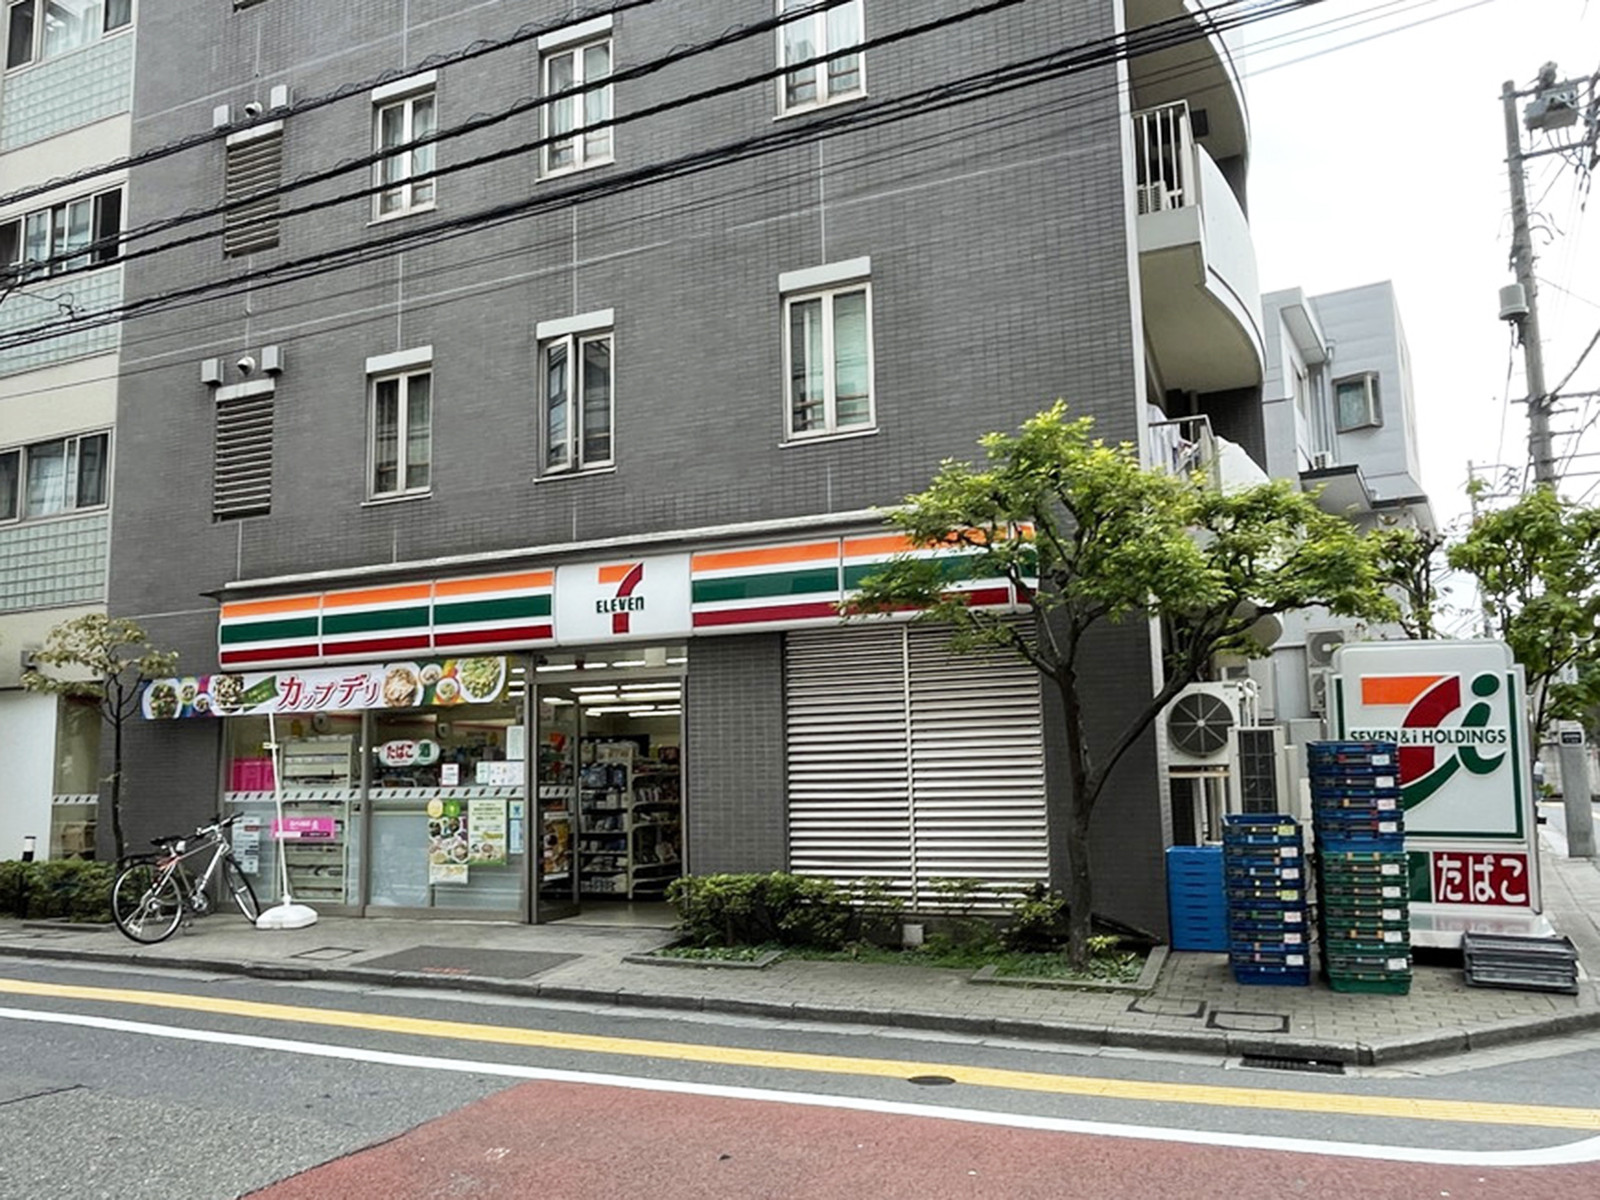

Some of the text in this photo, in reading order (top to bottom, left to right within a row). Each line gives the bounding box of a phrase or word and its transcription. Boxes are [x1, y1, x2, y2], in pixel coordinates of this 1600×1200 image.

[277, 673, 380, 709] カップデリ
[1350, 730, 1398, 743] SEVEN
[1401, 730, 1410, 744] &
[1422, 729, 1507, 744] HOLDINGS
[1437, 853, 1526, 903] たばこ
